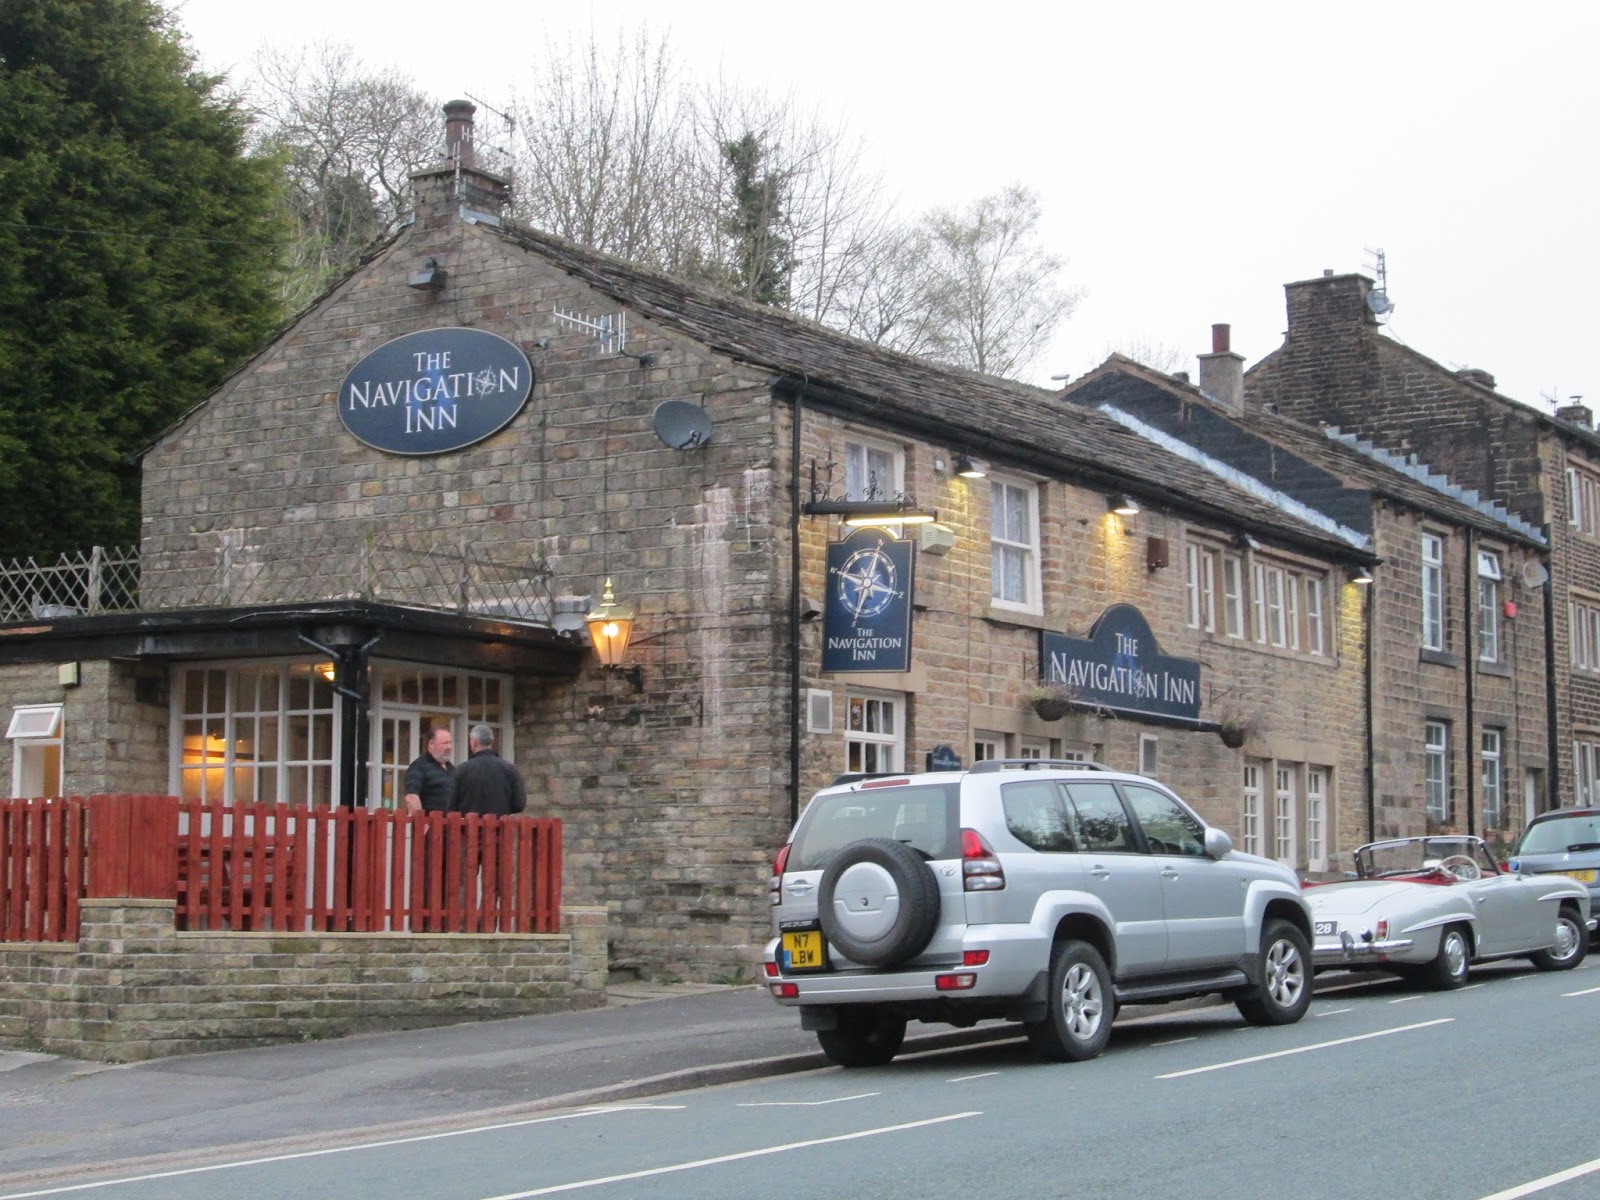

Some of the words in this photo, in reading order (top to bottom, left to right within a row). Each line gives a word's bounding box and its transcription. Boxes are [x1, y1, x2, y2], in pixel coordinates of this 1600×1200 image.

[413, 351, 451, 372] THE
[405, 404, 458, 433] INN
[856, 627, 873, 637] THE
[828, 637, 902, 649] NAVIGATION
[1115, 632, 1139, 657] THE
[853, 649, 876, 661] INN
[1164, 671, 1195, 705] INN
[1316, 923, 1332, 935] 28
[794, 934, 809, 948] N7
[791, 950, 814, 965] LBW
